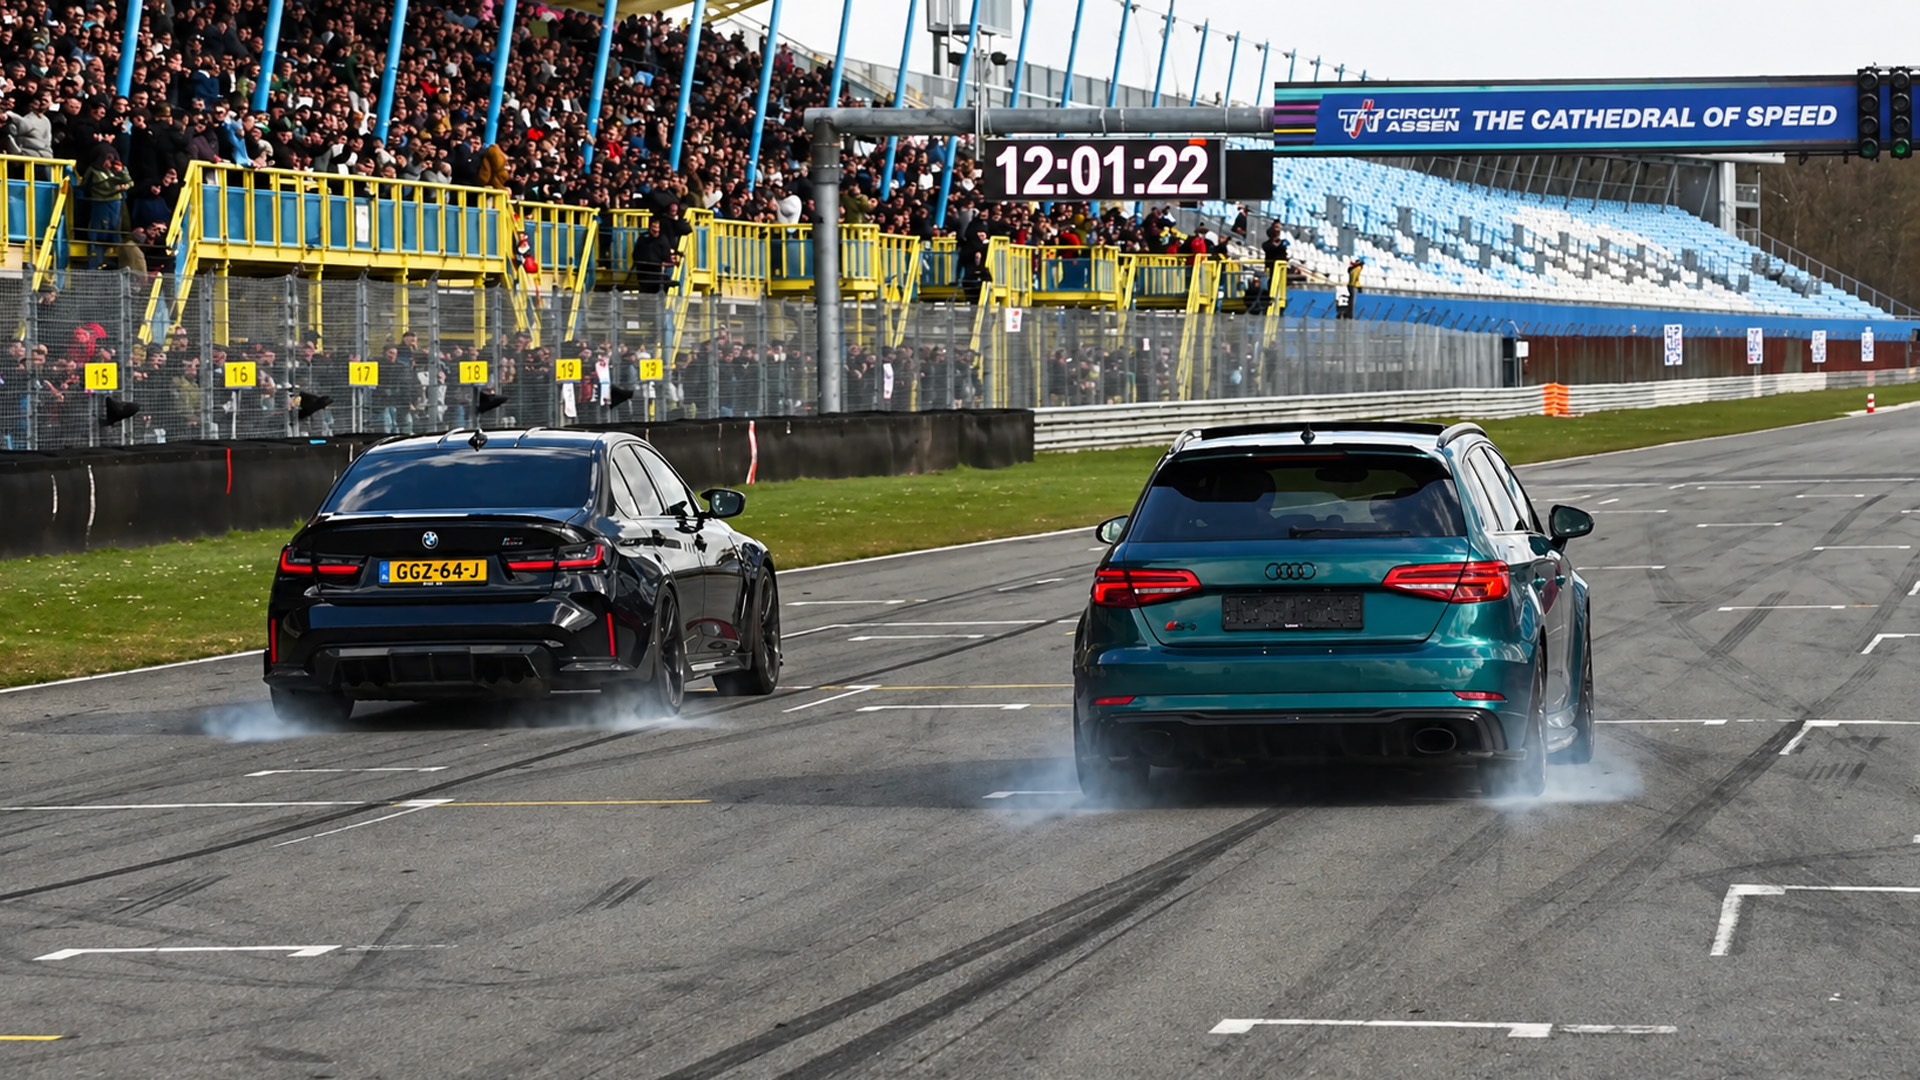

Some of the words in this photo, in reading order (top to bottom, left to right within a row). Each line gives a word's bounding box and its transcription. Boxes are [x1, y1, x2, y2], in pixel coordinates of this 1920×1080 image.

[1386, 107, 1460, 120] CIRCUIT
[1472, 109, 1526, 131] THE
[1531, 107, 1695, 131] CATHEDRAL
[1703, 106, 1741, 128] OF
[1746, 105, 1838, 127] SPEED
[1385, 120, 1460, 133] ASSEN
[995, 144, 1209, 196] 12:01:22
[94, 368, 109, 386] 15
[232, 366, 248, 383] 16
[357, 366, 371, 382] 17
[467, 364, 481, 381] 18
[561, 362, 574, 378] 19
[396, 562, 480, 580] GGZ-64-J
